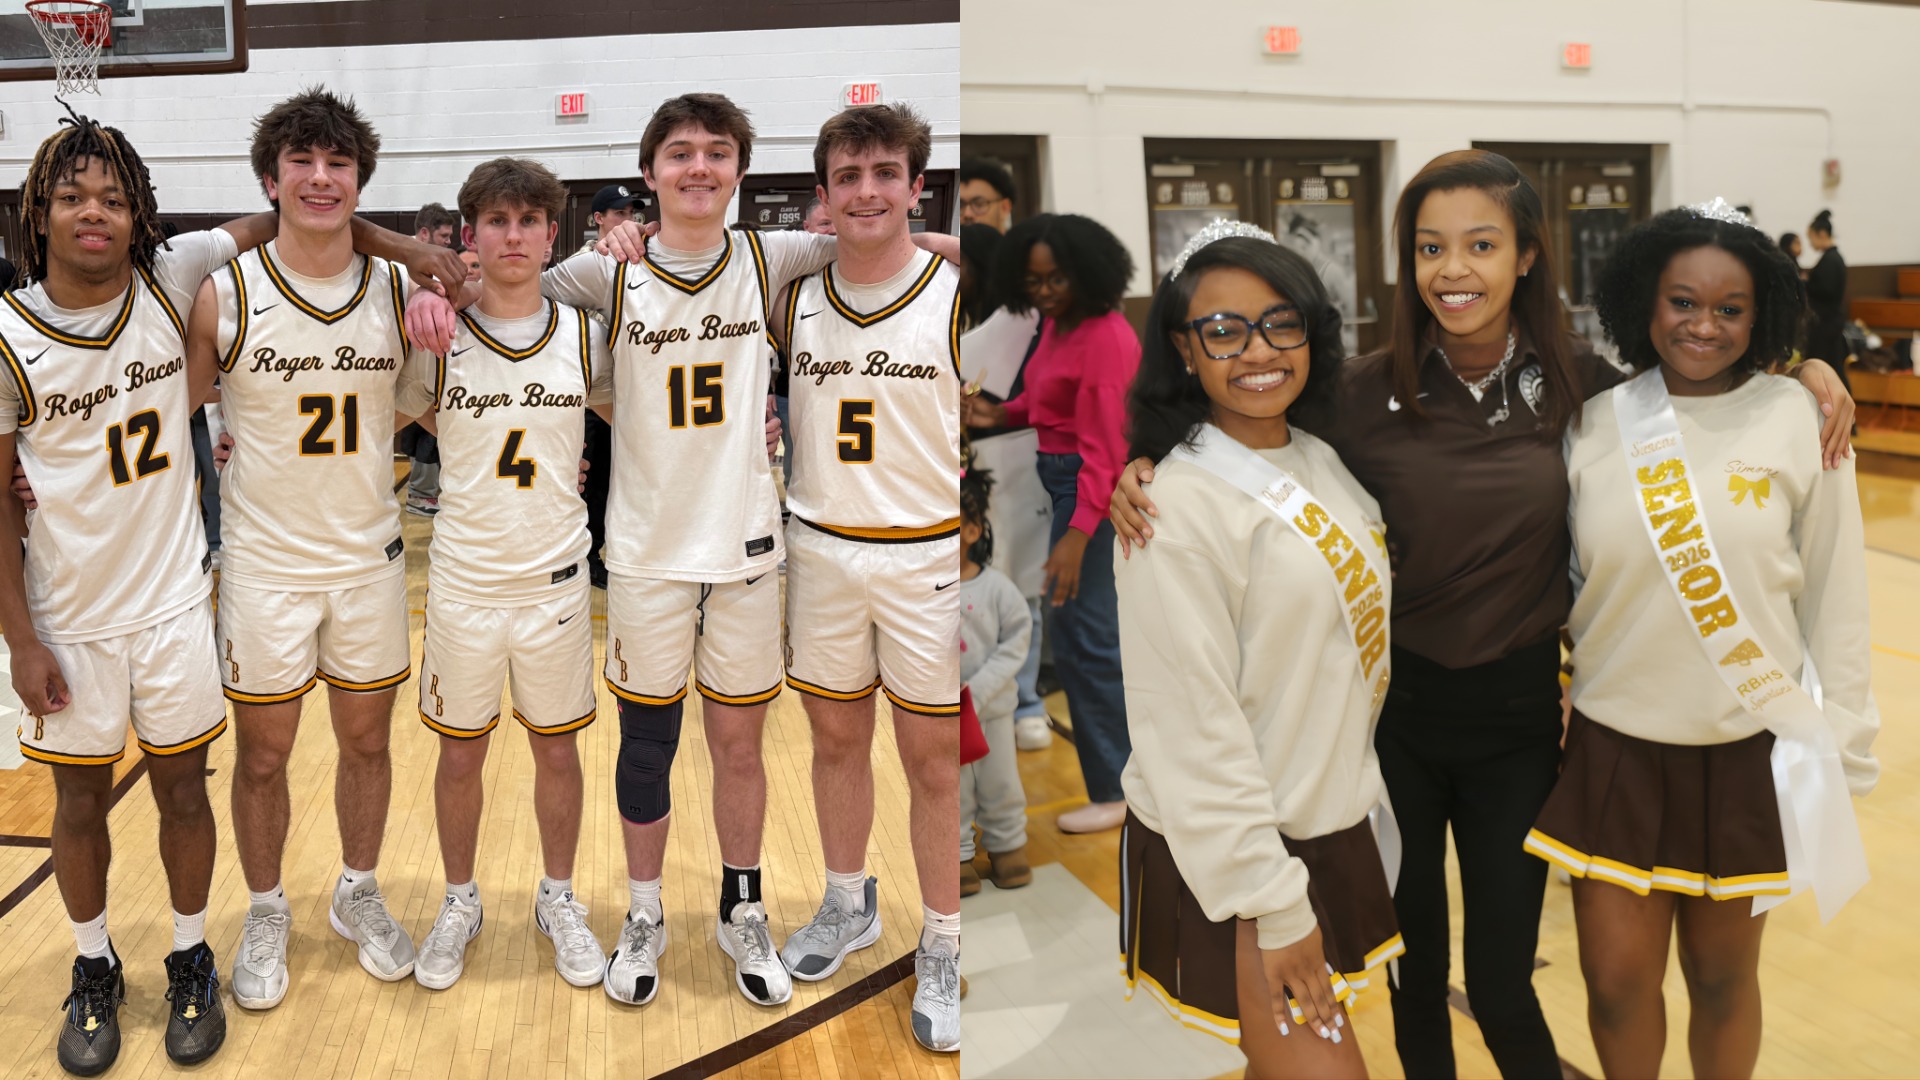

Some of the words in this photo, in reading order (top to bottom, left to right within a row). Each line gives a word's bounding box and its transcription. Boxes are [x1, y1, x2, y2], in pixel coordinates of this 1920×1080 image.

[561, 93, 584, 114] EXIT
[851, 83, 877, 105] EXIT
[778, 212, 800, 224] 1995
[628, 320, 690, 355] Roger
[698, 314, 760, 341] Bacon
[249, 347, 324, 382] Roger
[331, 345, 397, 371] Bacon
[794, 351, 853, 386] Roger
[860, 350, 939, 380] Bacon
[44, 384, 118, 422] Roger
[124, 356, 184, 393] Bacon
[445, 385, 513, 419] Roger
[519, 382, 584, 408] Bacon
[665, 361, 726, 430] 15
[297, 392, 360, 457] 21
[835, 398, 876, 465] 5
[105, 407, 172, 488] 12
[495, 427, 537, 490] 4
[1723, 460, 1780, 479] Simone
[1665, 541, 1711, 573] 2026
[1349, 584, 1383, 625] 2026
[1736, 669, 1783, 698] RBHS
